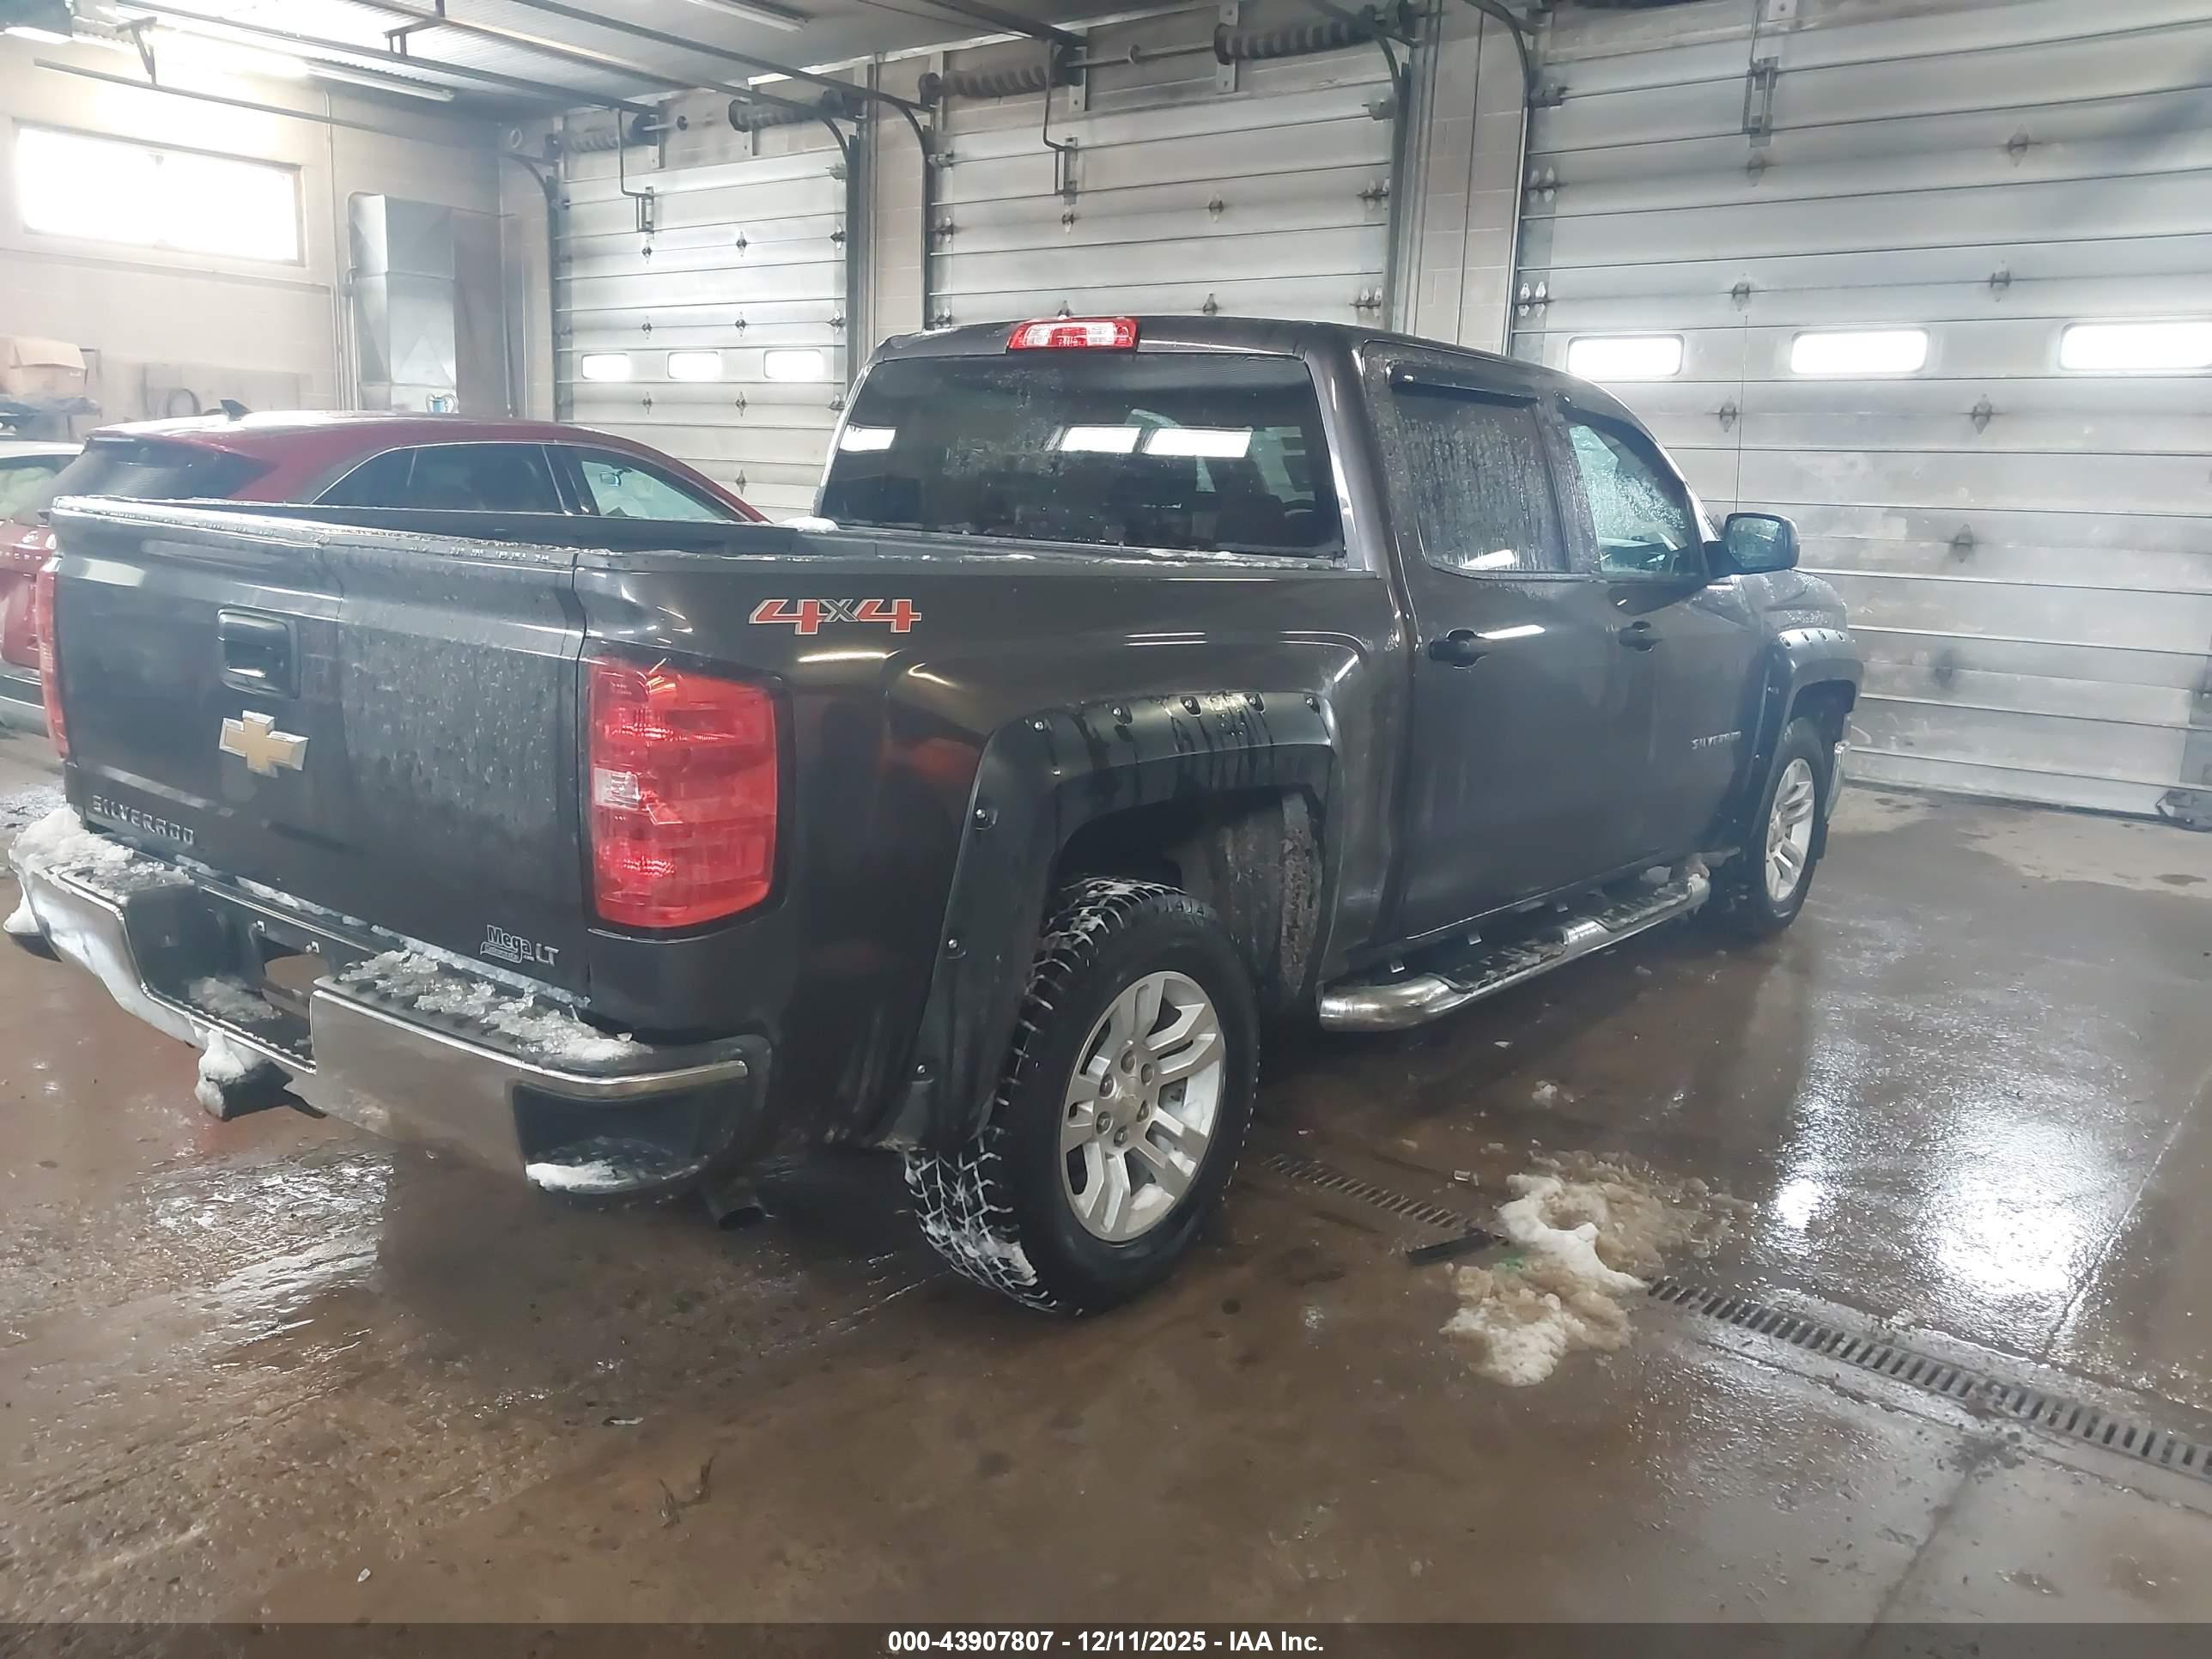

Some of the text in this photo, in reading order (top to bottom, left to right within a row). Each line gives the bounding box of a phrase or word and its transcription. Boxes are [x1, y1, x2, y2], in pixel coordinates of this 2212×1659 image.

[92, 794, 194, 846] SILVERADO
[486, 924, 532, 963] Mega
[536, 943, 560, 968] LT
